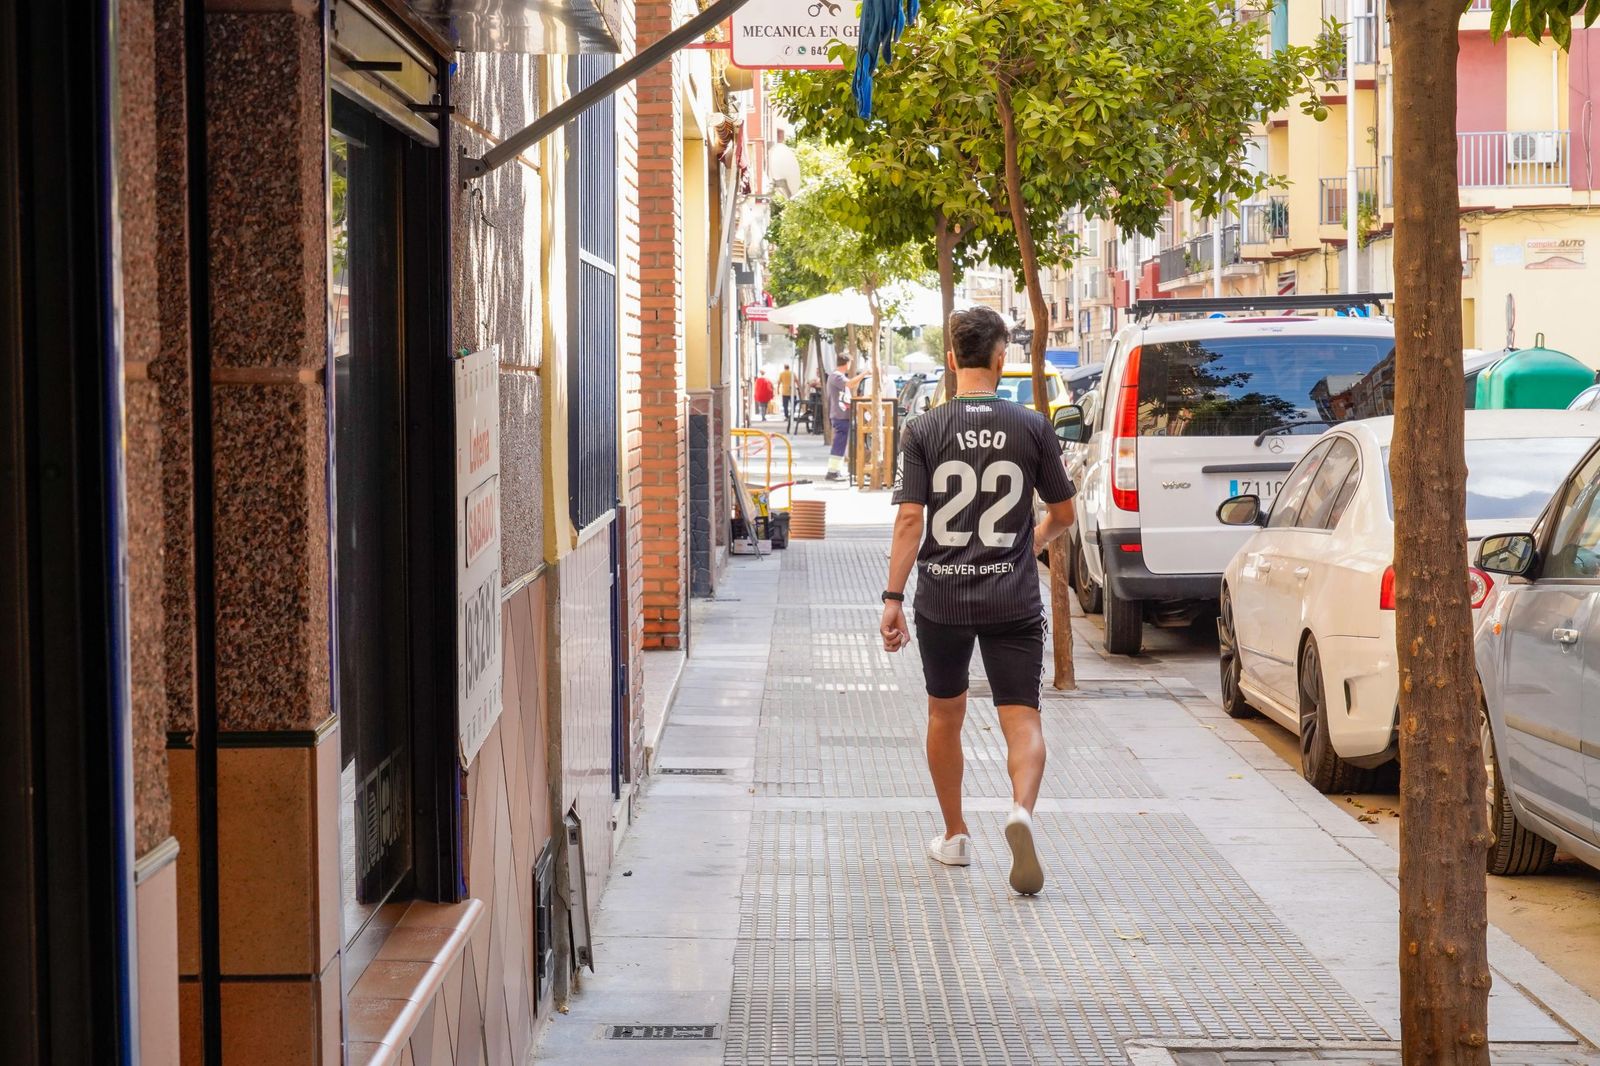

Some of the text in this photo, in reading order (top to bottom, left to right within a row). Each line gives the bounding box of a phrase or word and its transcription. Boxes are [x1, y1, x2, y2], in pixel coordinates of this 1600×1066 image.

[743, 25, 816, 38] MECANICA
[820, 25, 838, 38] EN
[1558, 239, 1586, 248] AUTO
[956, 429, 1007, 451] ISCO
[931, 460, 1024, 548] 22
[926, 562, 1015, 576] FOREVER GREEN
